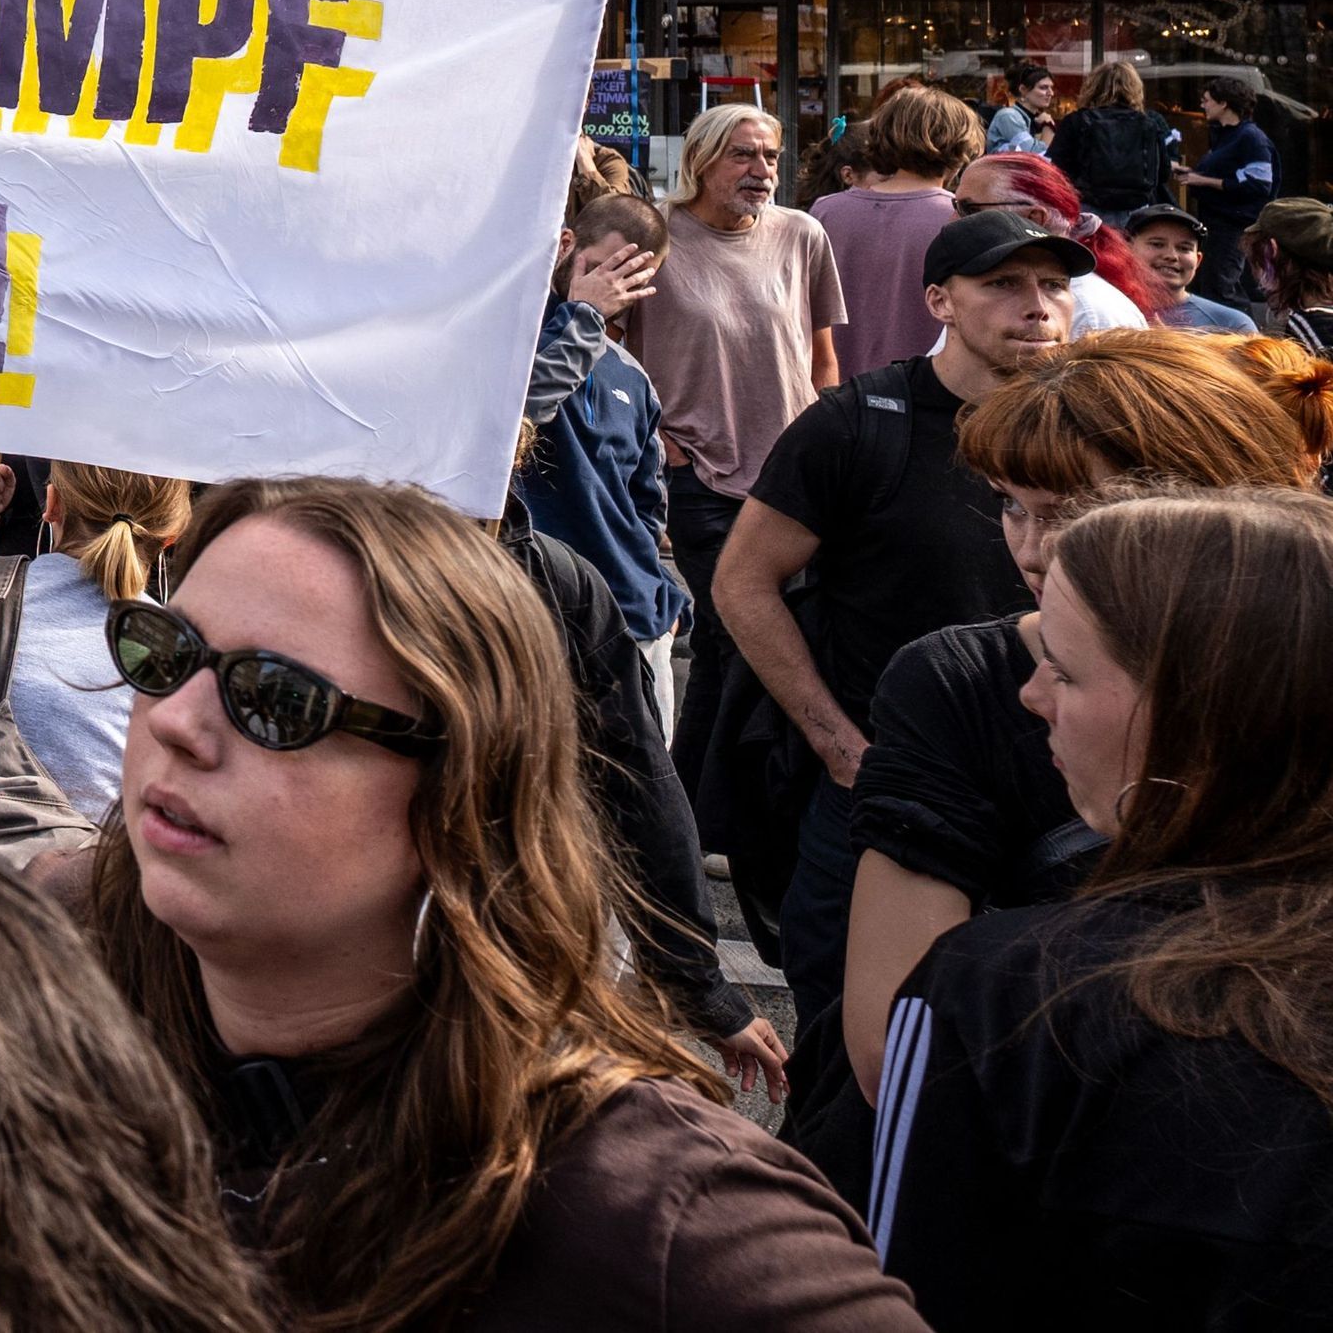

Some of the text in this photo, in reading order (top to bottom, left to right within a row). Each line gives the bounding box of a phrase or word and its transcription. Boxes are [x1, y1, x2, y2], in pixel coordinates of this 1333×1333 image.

[592, 70, 626, 80] KTIVE
[593, 82, 627, 92] GKEIT
[590, 104, 607, 114] EN
[612, 111, 650, 128] KÖN,
